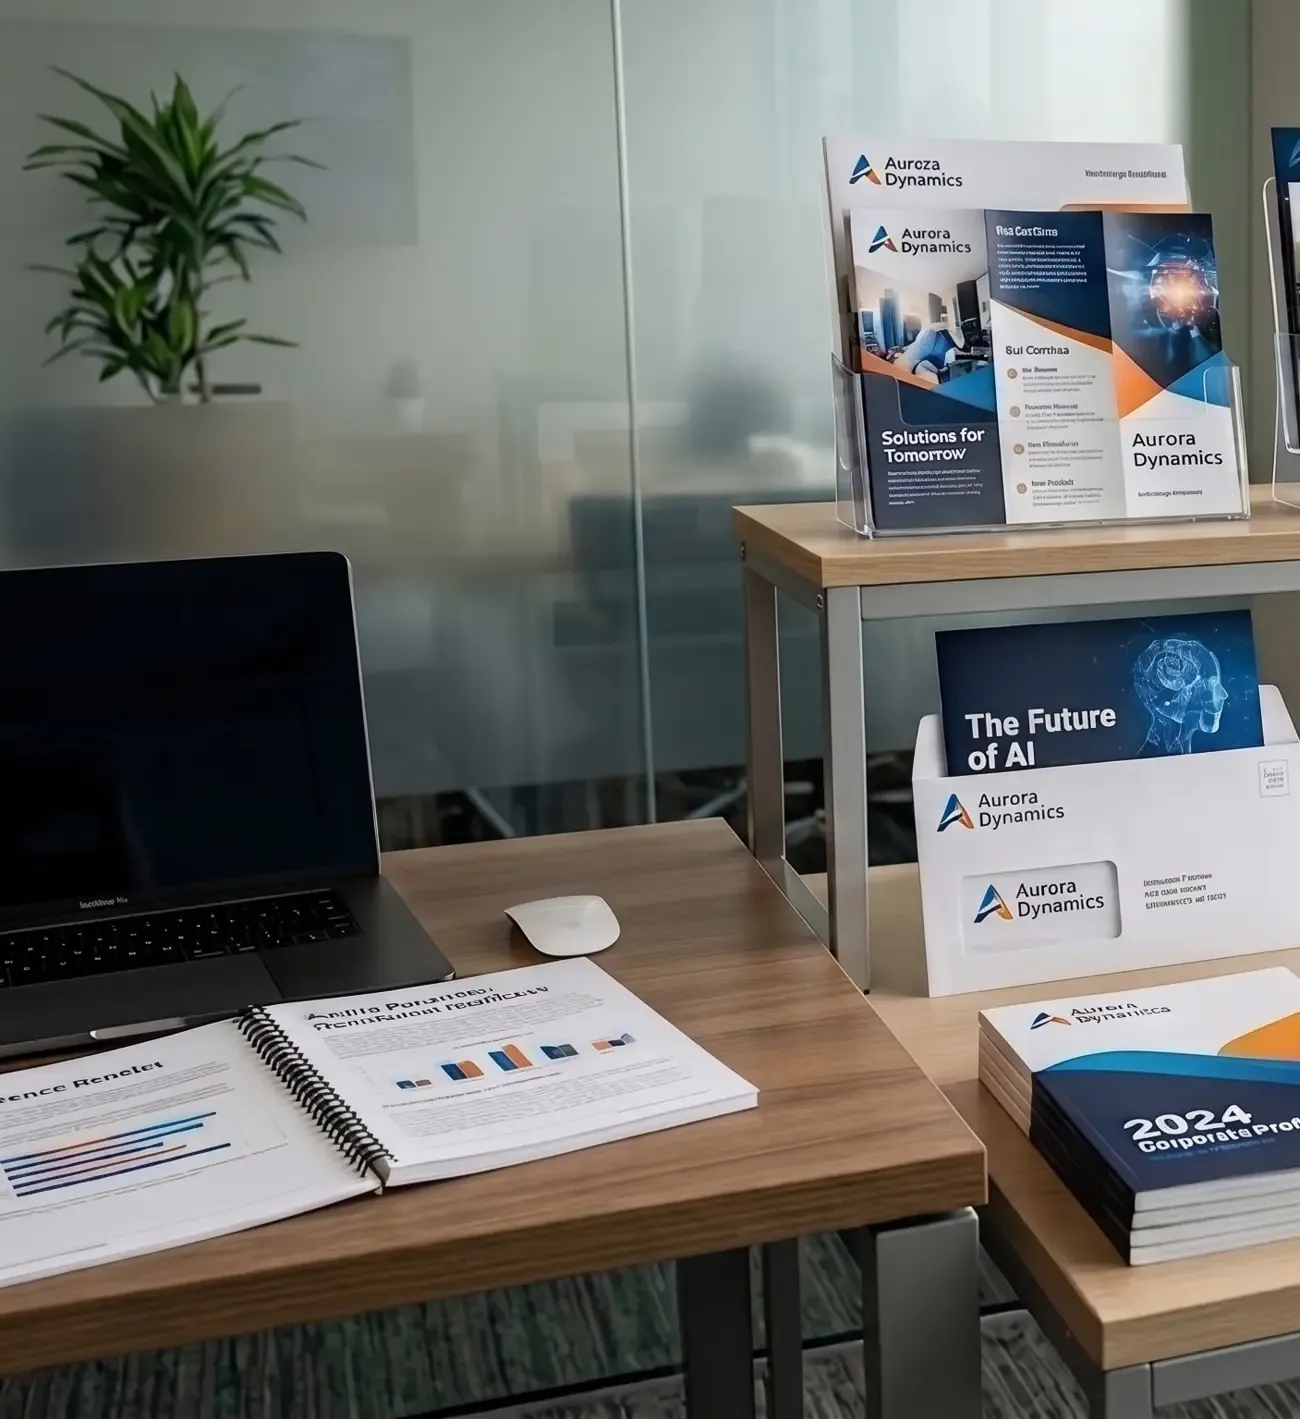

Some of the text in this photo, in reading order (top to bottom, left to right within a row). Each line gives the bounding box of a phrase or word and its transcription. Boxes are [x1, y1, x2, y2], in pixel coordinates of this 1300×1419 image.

[885, 172, 963, 189] Dynamics
[901, 228, 951, 239] Aurora
[901, 240, 972, 256] Dynamics
[881, 427, 985, 445] Solutions for
[1132, 433, 1196, 447] Aurora
[884, 448, 967, 463] Tomorrow
[1134, 450, 1223, 470] Dynamics
[964, 707, 1117, 739] The Future
[967, 741, 1036, 771] of AI
[978, 792, 1038, 808] Aurora
[979, 805, 1065, 830] Dynamics
[1015, 881, 1077, 899] Aurora
[1017, 894, 1105, 920] Dynamics
[1123, 1104, 1252, 1141] 2024
